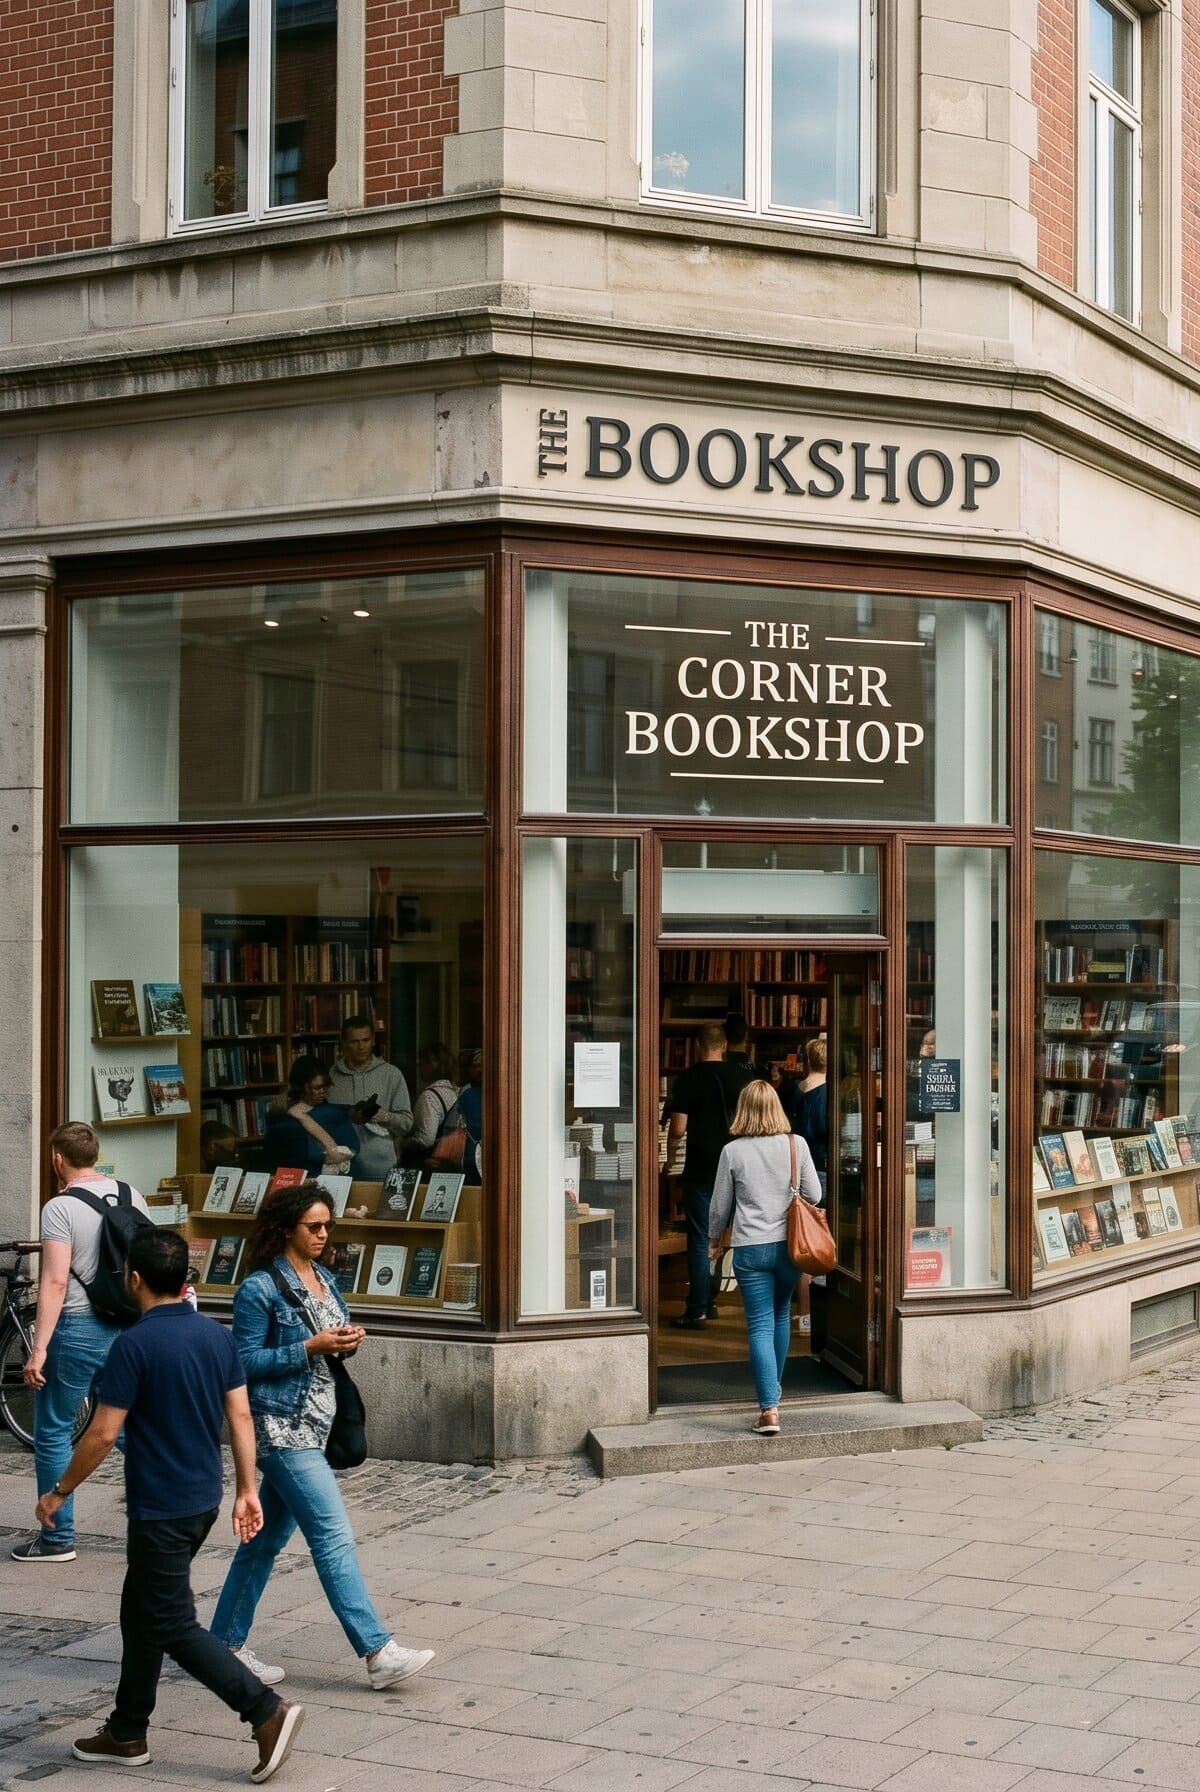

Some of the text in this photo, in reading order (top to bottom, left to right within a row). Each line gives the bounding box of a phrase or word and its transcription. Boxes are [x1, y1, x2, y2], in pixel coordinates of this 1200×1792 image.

[538, 407, 1001, 510] THE BOOKSHOP
[744, 620, 811, 651] THE
[677, 656, 892, 708] CORNER
[624, 711, 925, 765] BOOKSHOP
